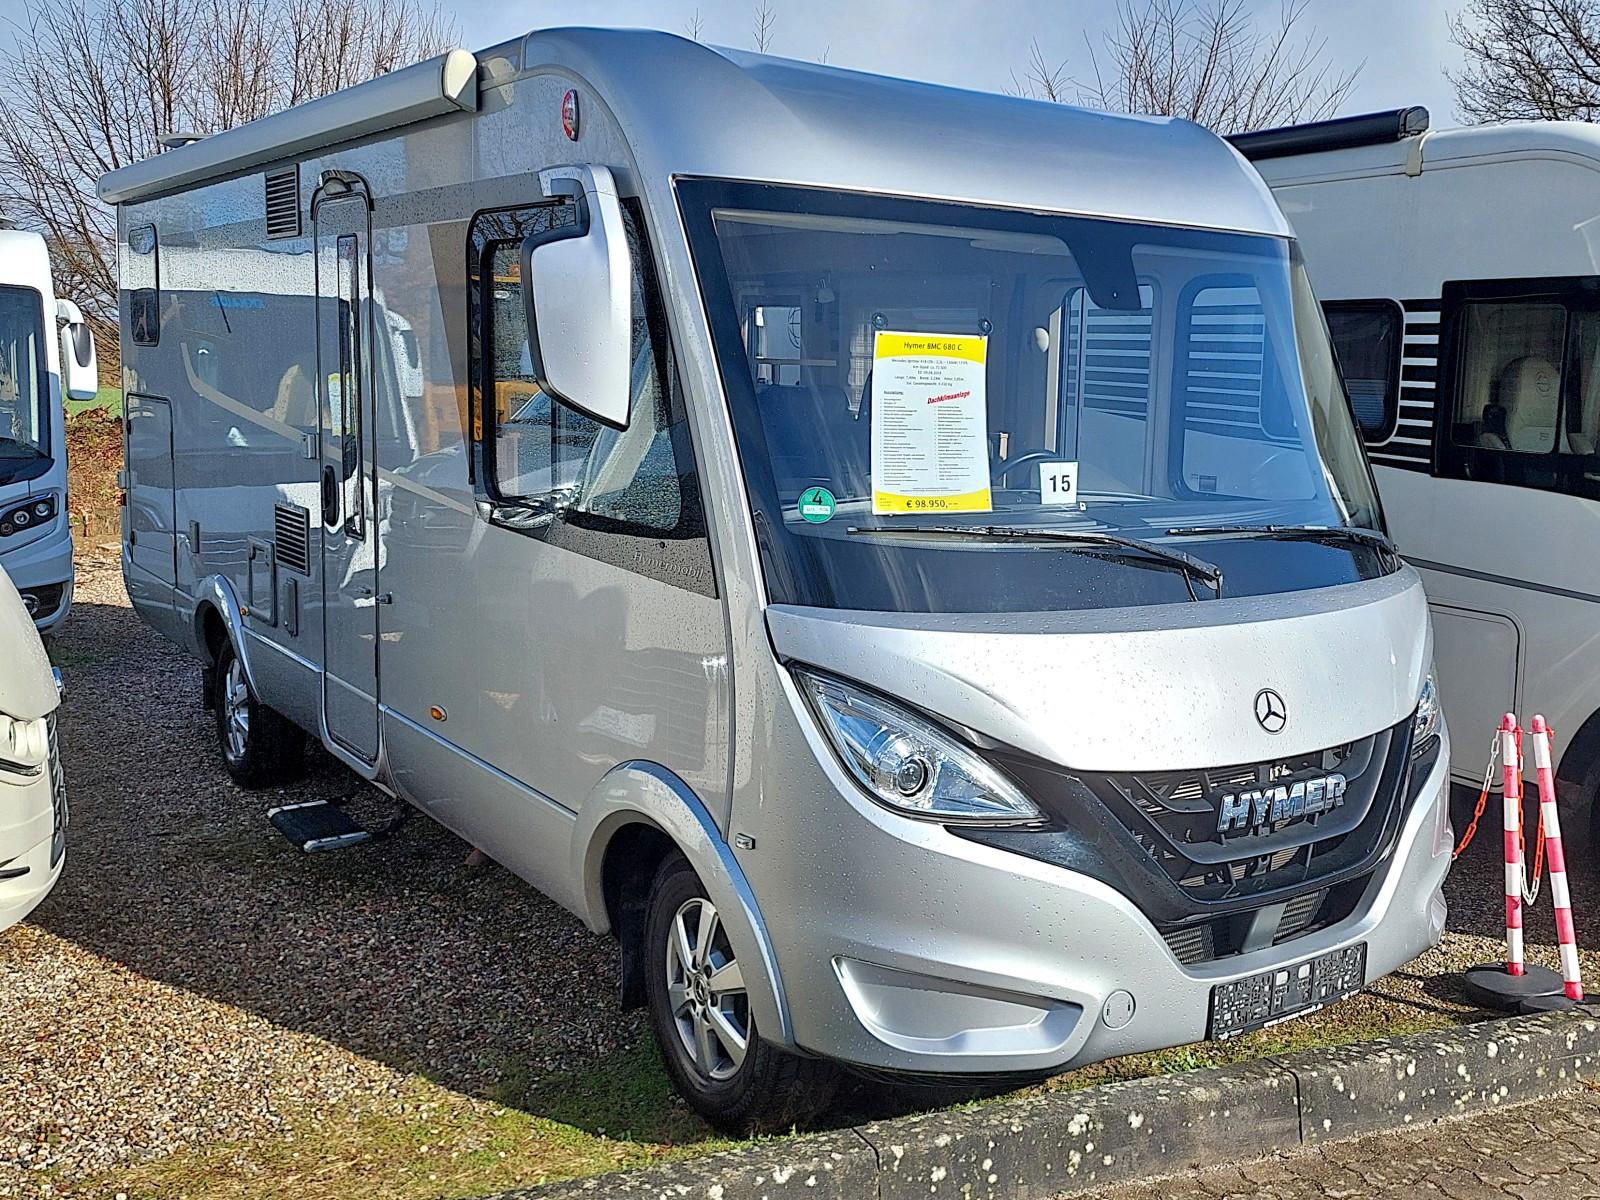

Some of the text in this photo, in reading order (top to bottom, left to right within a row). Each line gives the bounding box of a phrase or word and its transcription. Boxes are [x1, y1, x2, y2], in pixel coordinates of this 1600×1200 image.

[904, 342, 925, 351] Hymer
[943, 343, 956, 351] 680
[927, 391, 971, 404] Dachklimaanlage
[1049, 474, 1071, 493] 15
[812, 490, 823, 506] 4
[633, 551, 705, 579] Hymermobil
[1217, 773, 1347, 833] HYMER
